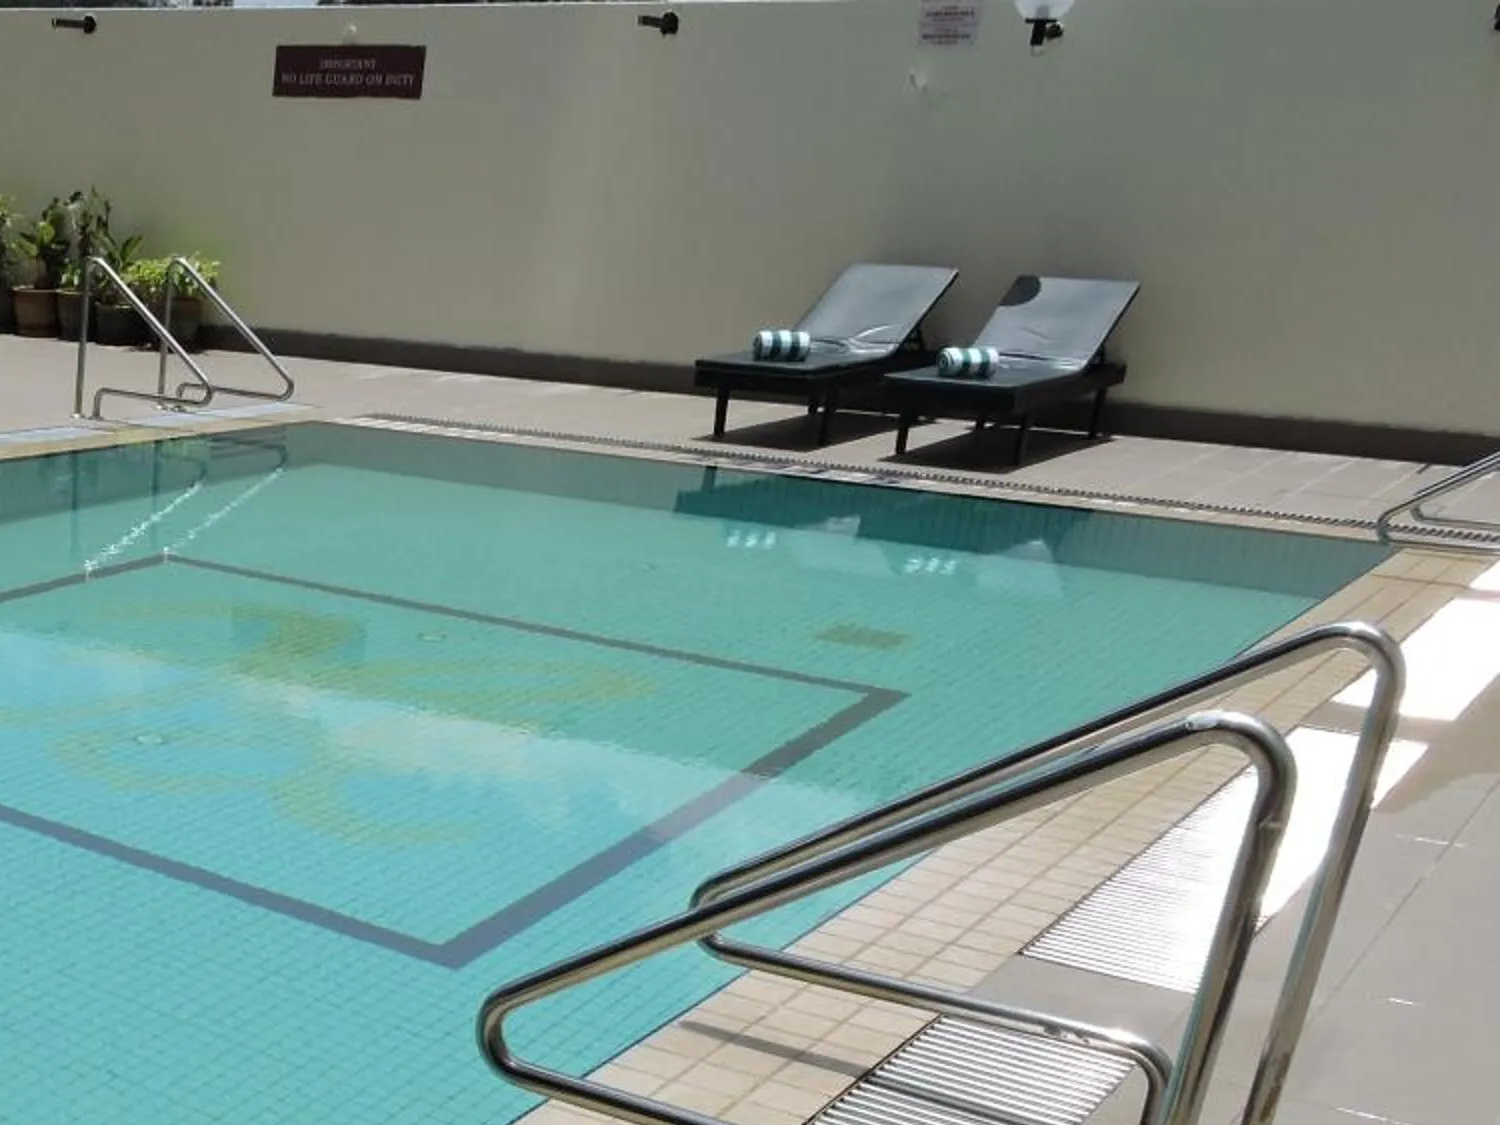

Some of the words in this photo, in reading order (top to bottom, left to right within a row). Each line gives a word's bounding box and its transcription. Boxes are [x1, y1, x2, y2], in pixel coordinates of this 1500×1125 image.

[281, 73, 297, 84] NO
[299, 73, 323, 85] LIFE
[325, 74, 363, 85] GUARD
[365, 74, 383, 85] ON
[385, 74, 416, 87] DUTY
